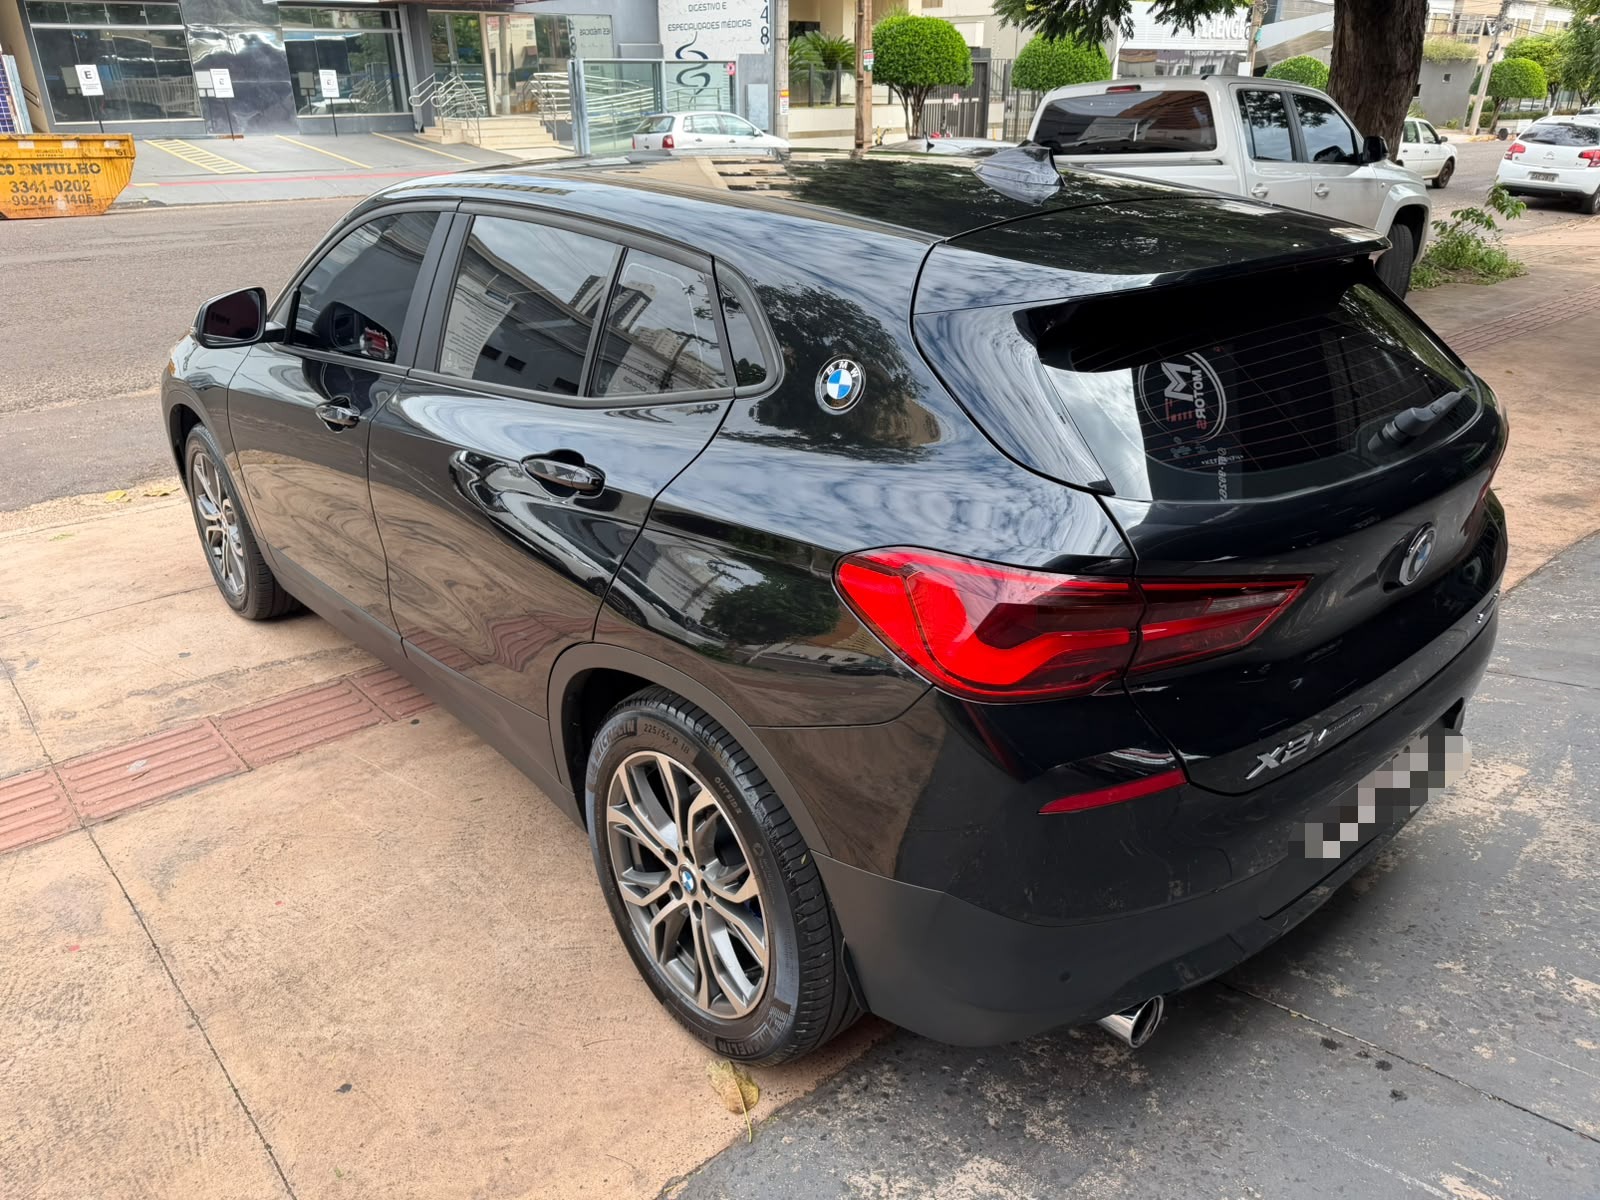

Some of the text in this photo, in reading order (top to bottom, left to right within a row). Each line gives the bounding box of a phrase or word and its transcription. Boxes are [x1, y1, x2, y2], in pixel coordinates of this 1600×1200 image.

[688, 2, 727, 12] DIGESTIVO E
[667, 18, 752, 32] ESPECIALIDADES MÉDICAS
[84, 70, 93, 80] E
[18, 162, 101, 176] ENTULHO
[9, 179, 91, 193] 3341-0202
[826, 361, 860, 378] BMW
[643, 723, 671, 741] 225/55
[1245, 731, 1314, 780] X2
[714, 776, 743, 815] OUTSIDE
